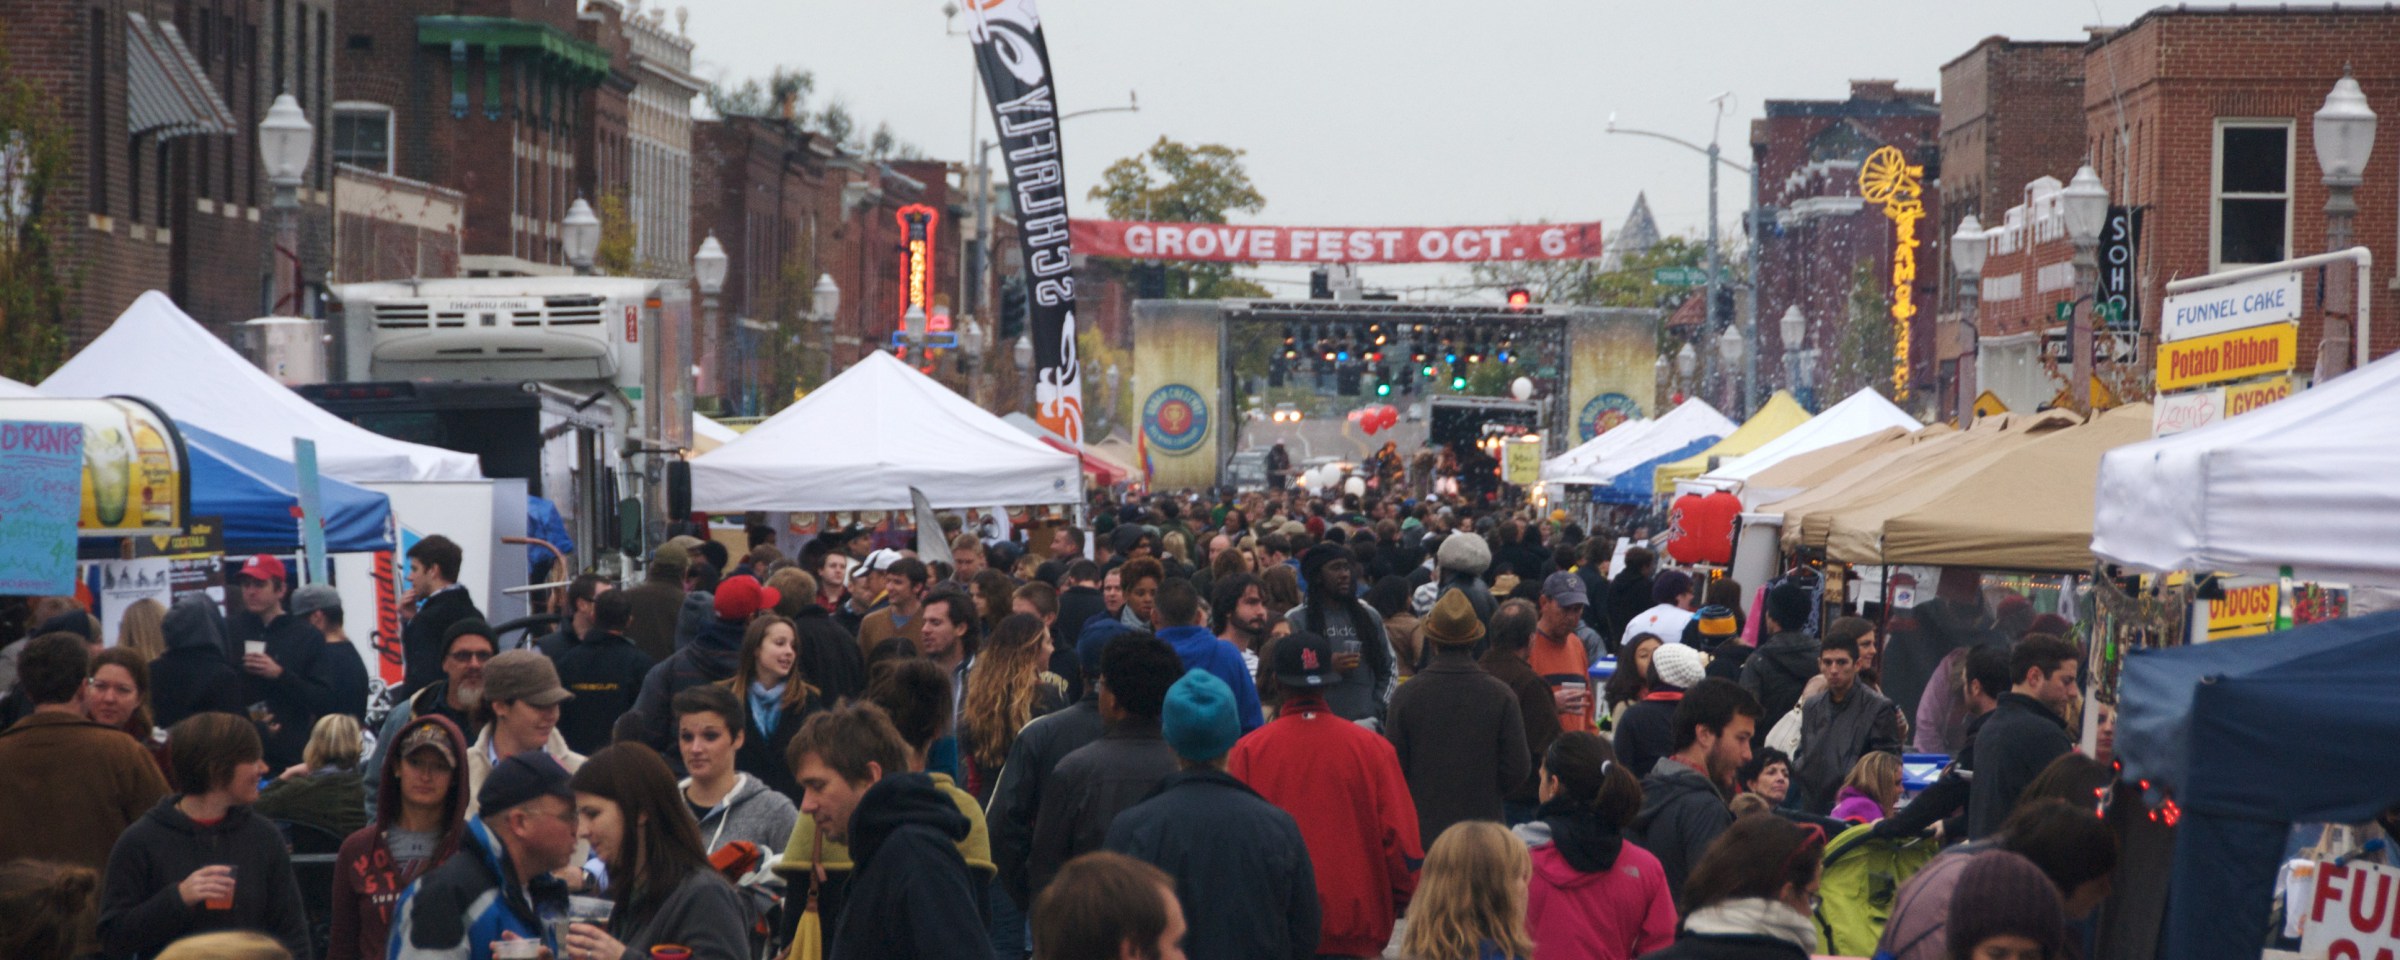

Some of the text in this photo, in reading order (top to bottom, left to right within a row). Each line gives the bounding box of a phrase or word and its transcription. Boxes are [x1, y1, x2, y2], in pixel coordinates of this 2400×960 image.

[1123, 224, 1567, 261] GROVE FEST OCT. 6
[2108, 216, 2128, 313] SOHO
[2177, 288, 2286, 326] FUNNEL CAKE
[2170, 335, 2279, 381] Potato Ribbon
[2209, 585, 2271, 620] OTDOGS
